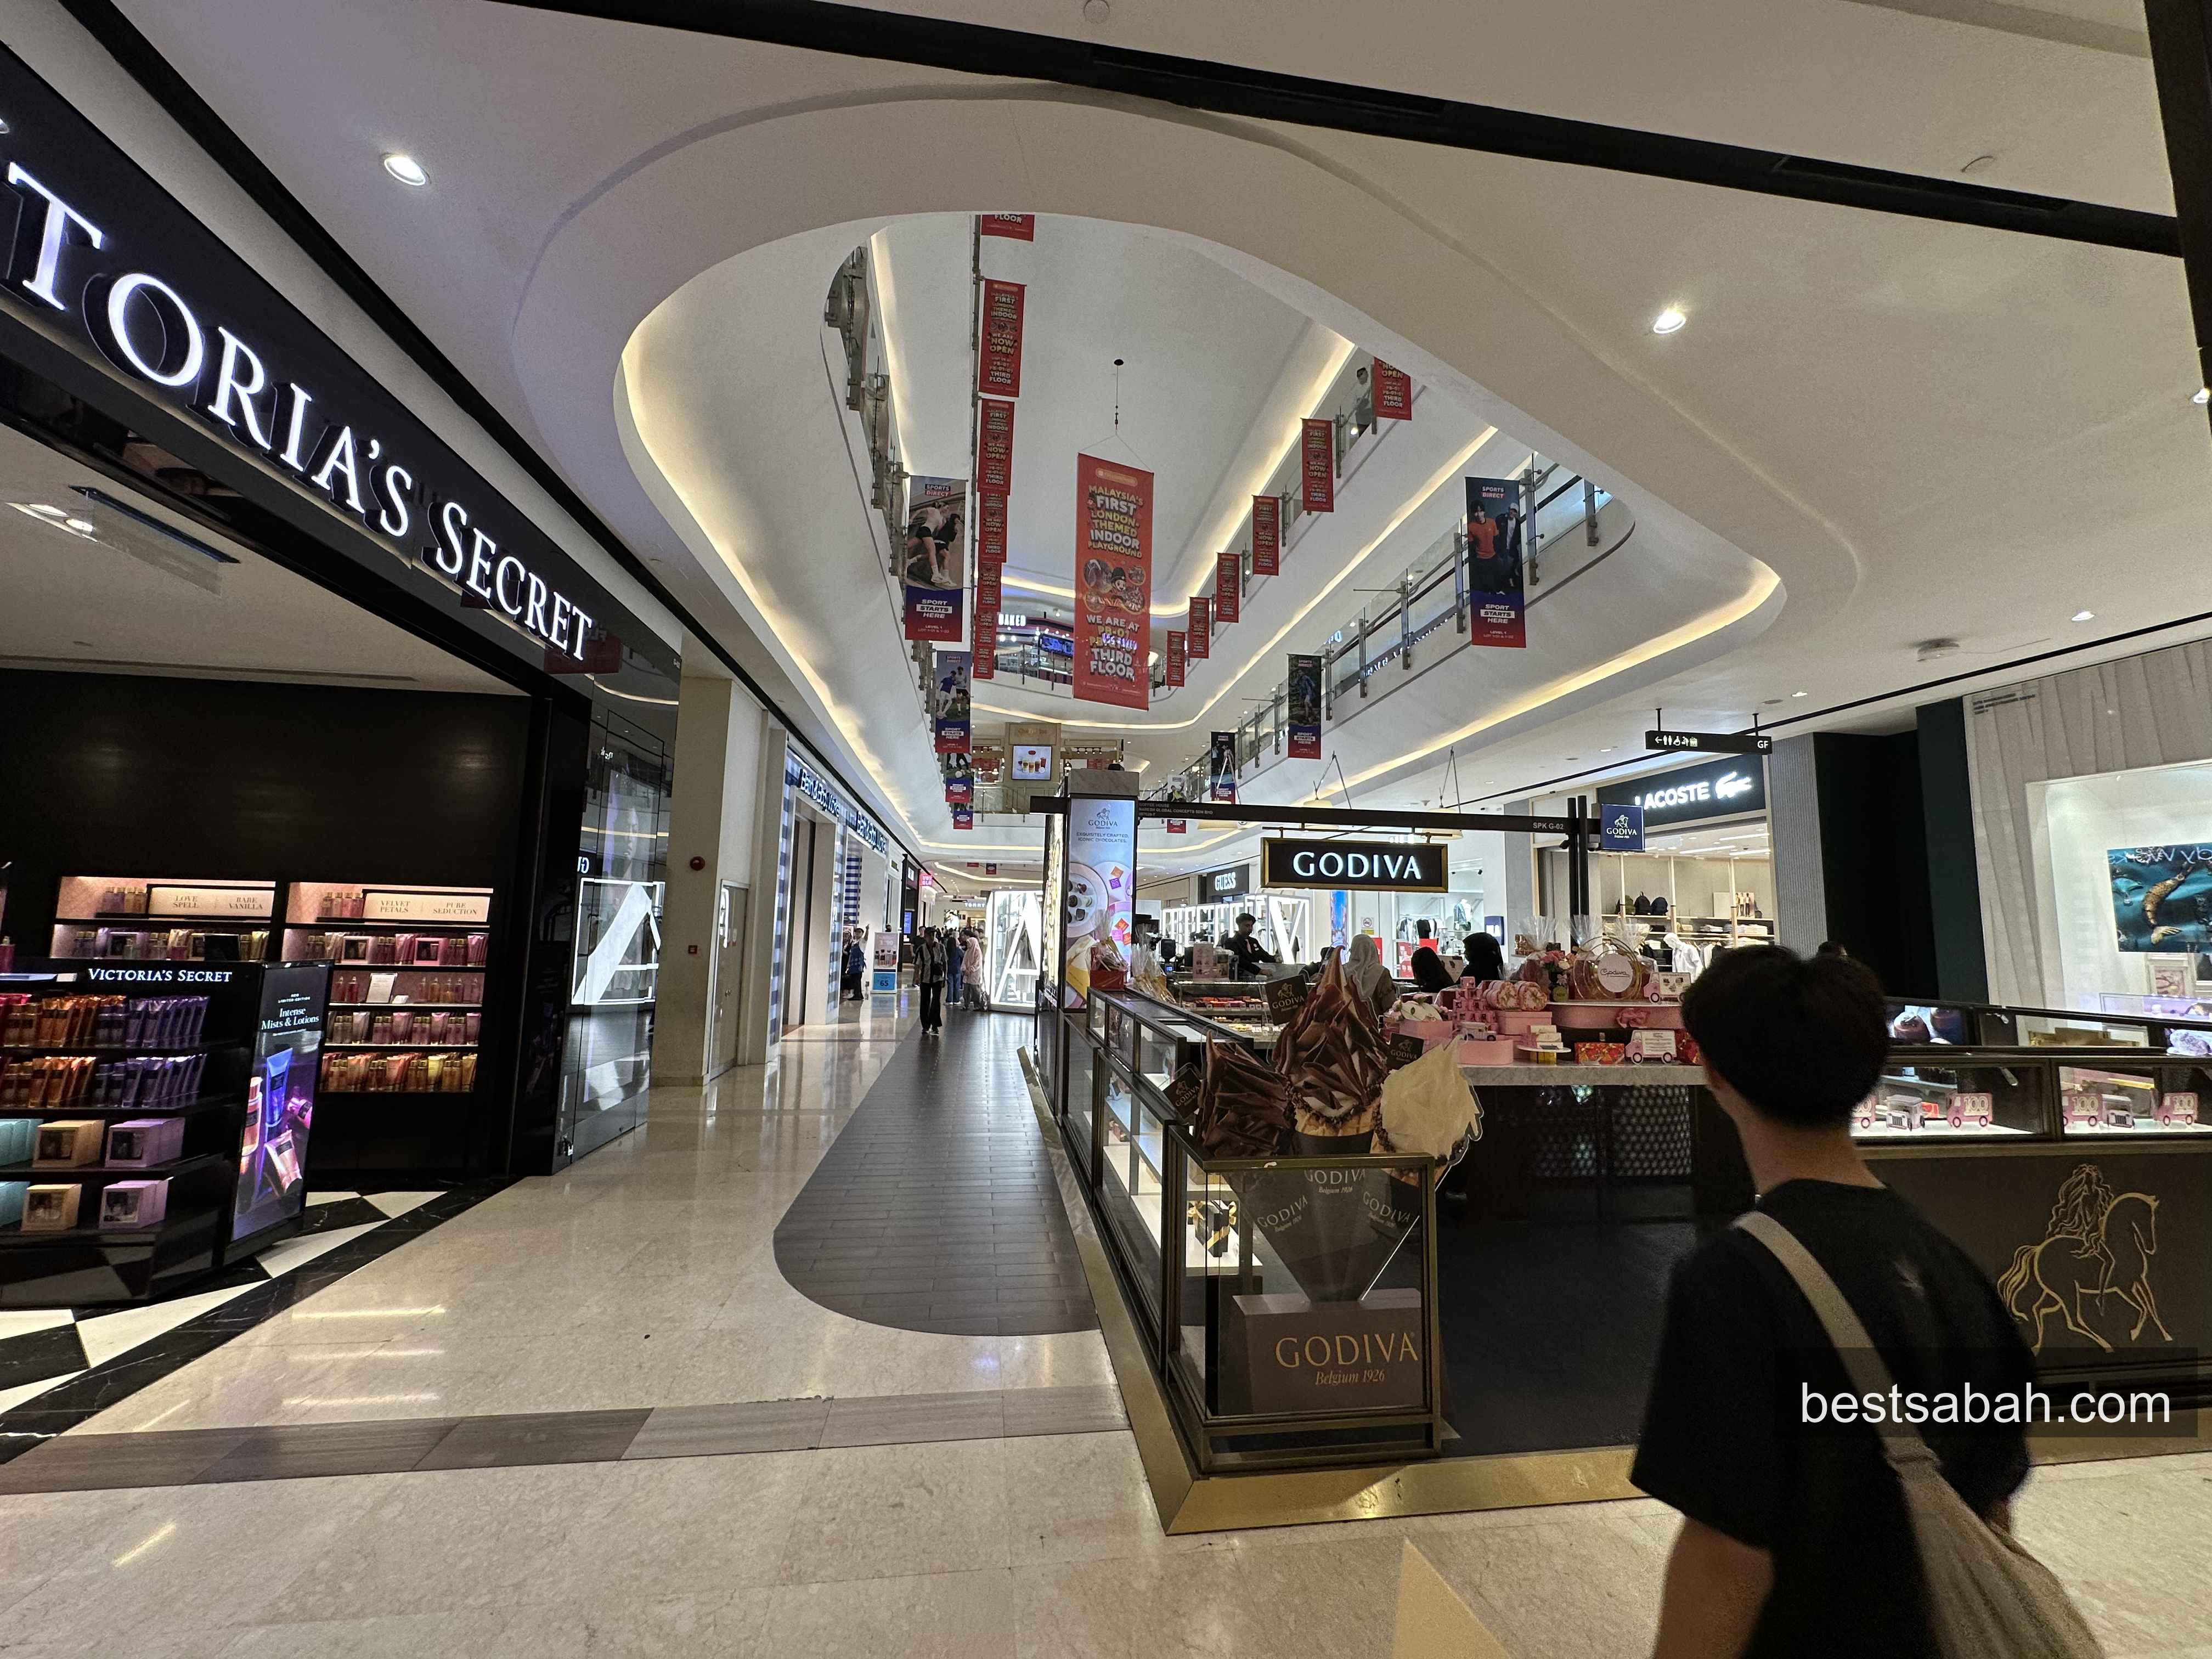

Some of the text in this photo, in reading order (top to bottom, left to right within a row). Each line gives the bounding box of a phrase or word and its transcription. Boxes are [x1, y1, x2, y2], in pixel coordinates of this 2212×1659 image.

[995, 215, 1022, 223] FLOOR
[991, 311, 1017, 319] INDOOR
[990, 346, 1014, 355] OPEN
[991, 338, 1014, 347] NOW
[1382, 370, 1403, 378] OPEN
[0, 117, 591, 661] TORIA'S SECRET
[1088, 485, 1143, 506] MALAYSIA'S
[1097, 495, 1136, 515] FIRST
[1091, 510, 1139, 527] LONDON-
[1092, 519, 1137, 537] THEMED
[1090, 529, 1140, 549] INDOOR
[1088, 540, 1142, 558] PLAYGROUND
[1086, 614, 1140, 632] WE ARE AT
[1097, 625, 1130, 638] PB-01
[1091, 647, 1133, 665] THIRD
[1090, 661, 1135, 681] FLOOR
[1757, 741, 1769, 749] GF
[1606, 827, 1638, 836] GODIVA
[1293, 851, 1422, 880] GODIVA
[1214, 871, 1237, 891] GUESS
[88, 968, 233, 983] VICTORIA'S SECRET
[1272, 995, 1305, 1009] GODIVA
[279, 1008, 306, 1018] Intense
[261, 1015, 319, 1030] Mists & Lotions
[1391, 1049, 1417, 1059] GODIVA
[1176, 1085, 1200, 1107] GODIVA
[1965, 1096, 1989, 1111] 100
[2072, 1097, 2098, 1111] 100
[1304, 1168, 1365, 1185] GODIVA
[1257, 1195, 1308, 1228] GODIVA
[1363, 1191, 1410, 1223] GODIVA
[1275, 1332, 1419, 1368] GODIVA
[1314, 1369, 1385, 1386] Belgium 1926
